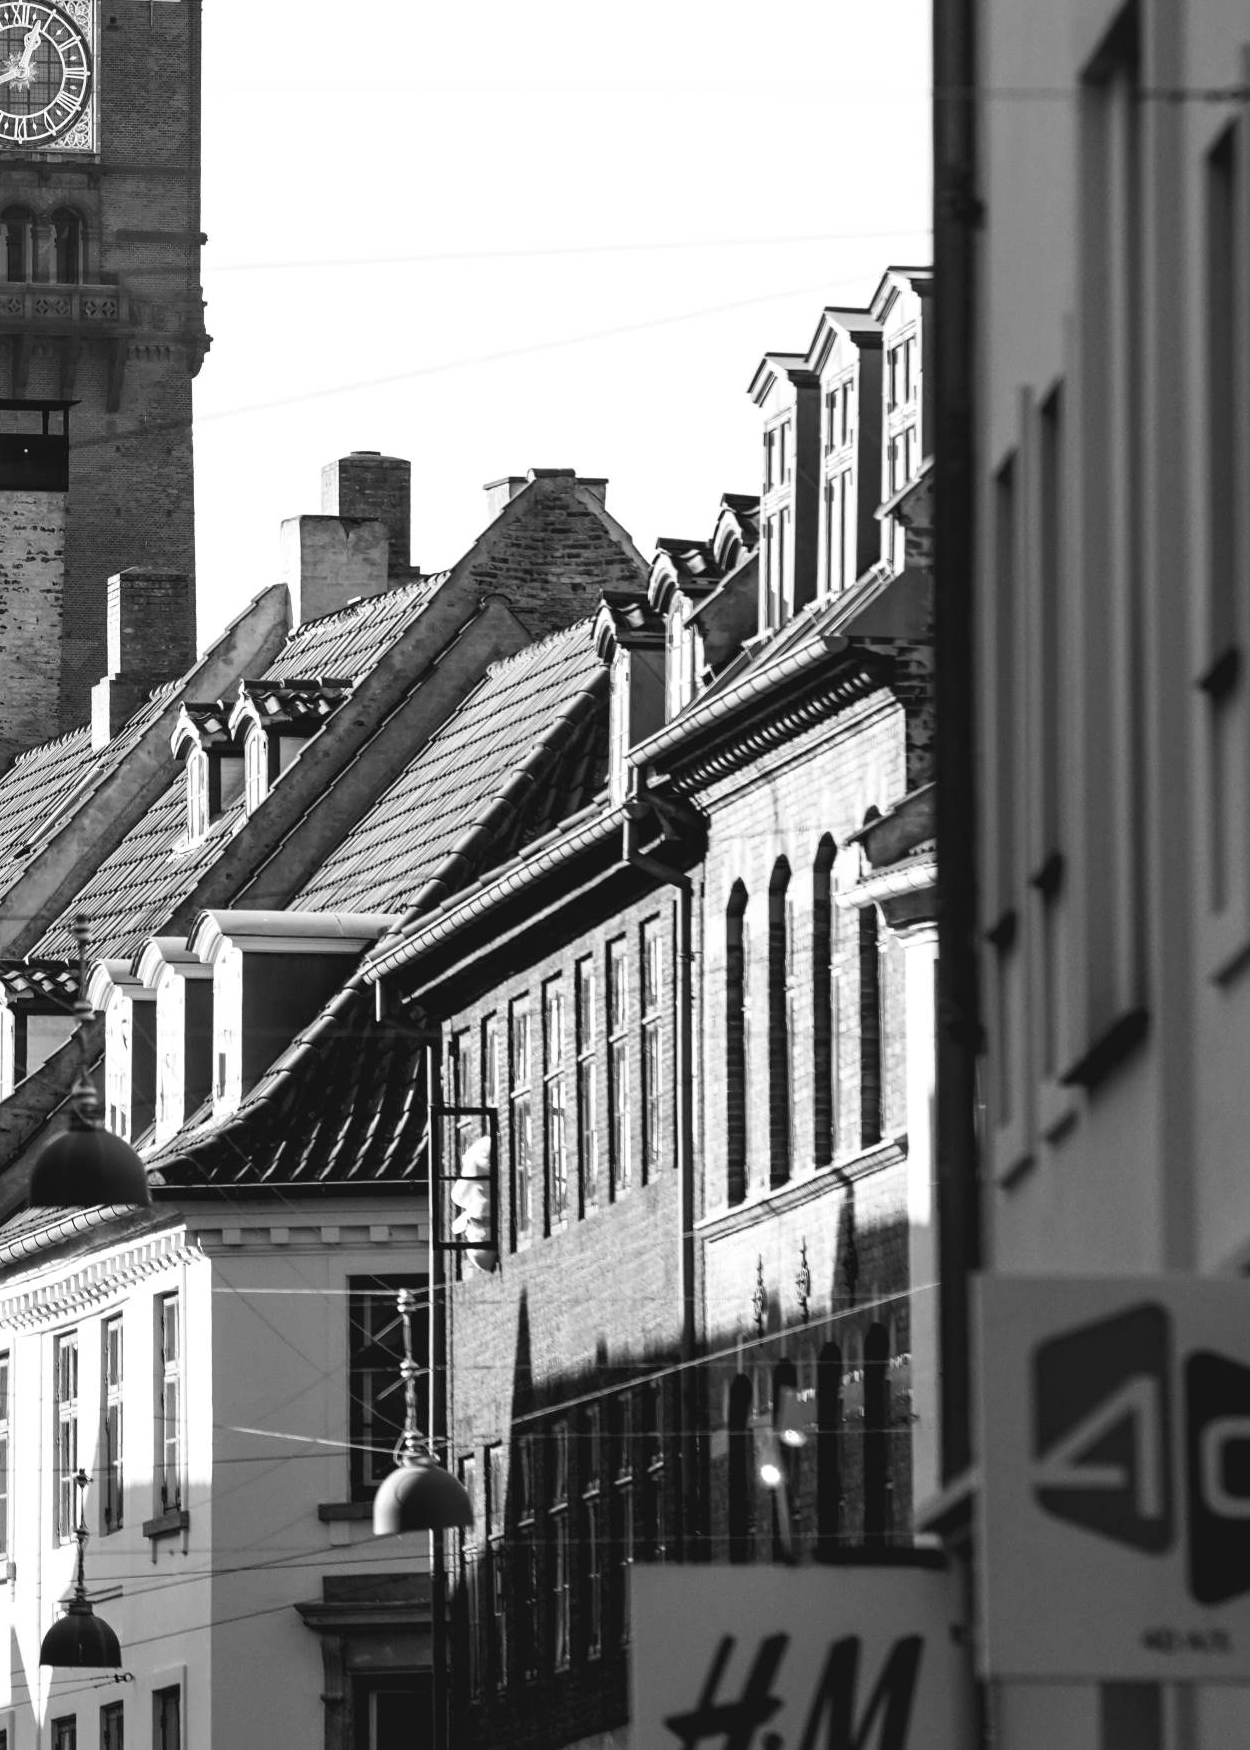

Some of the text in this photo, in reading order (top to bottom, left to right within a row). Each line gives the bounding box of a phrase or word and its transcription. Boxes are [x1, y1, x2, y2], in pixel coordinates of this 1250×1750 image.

[11, 3, 31, 26] XII
[58, 36, 79, 51] II
[64, 68, 86, 79] III
[13, 117, 28, 138] VI
[44, 111, 56, 132] V
[663, 1631, 926, 1750] HM
